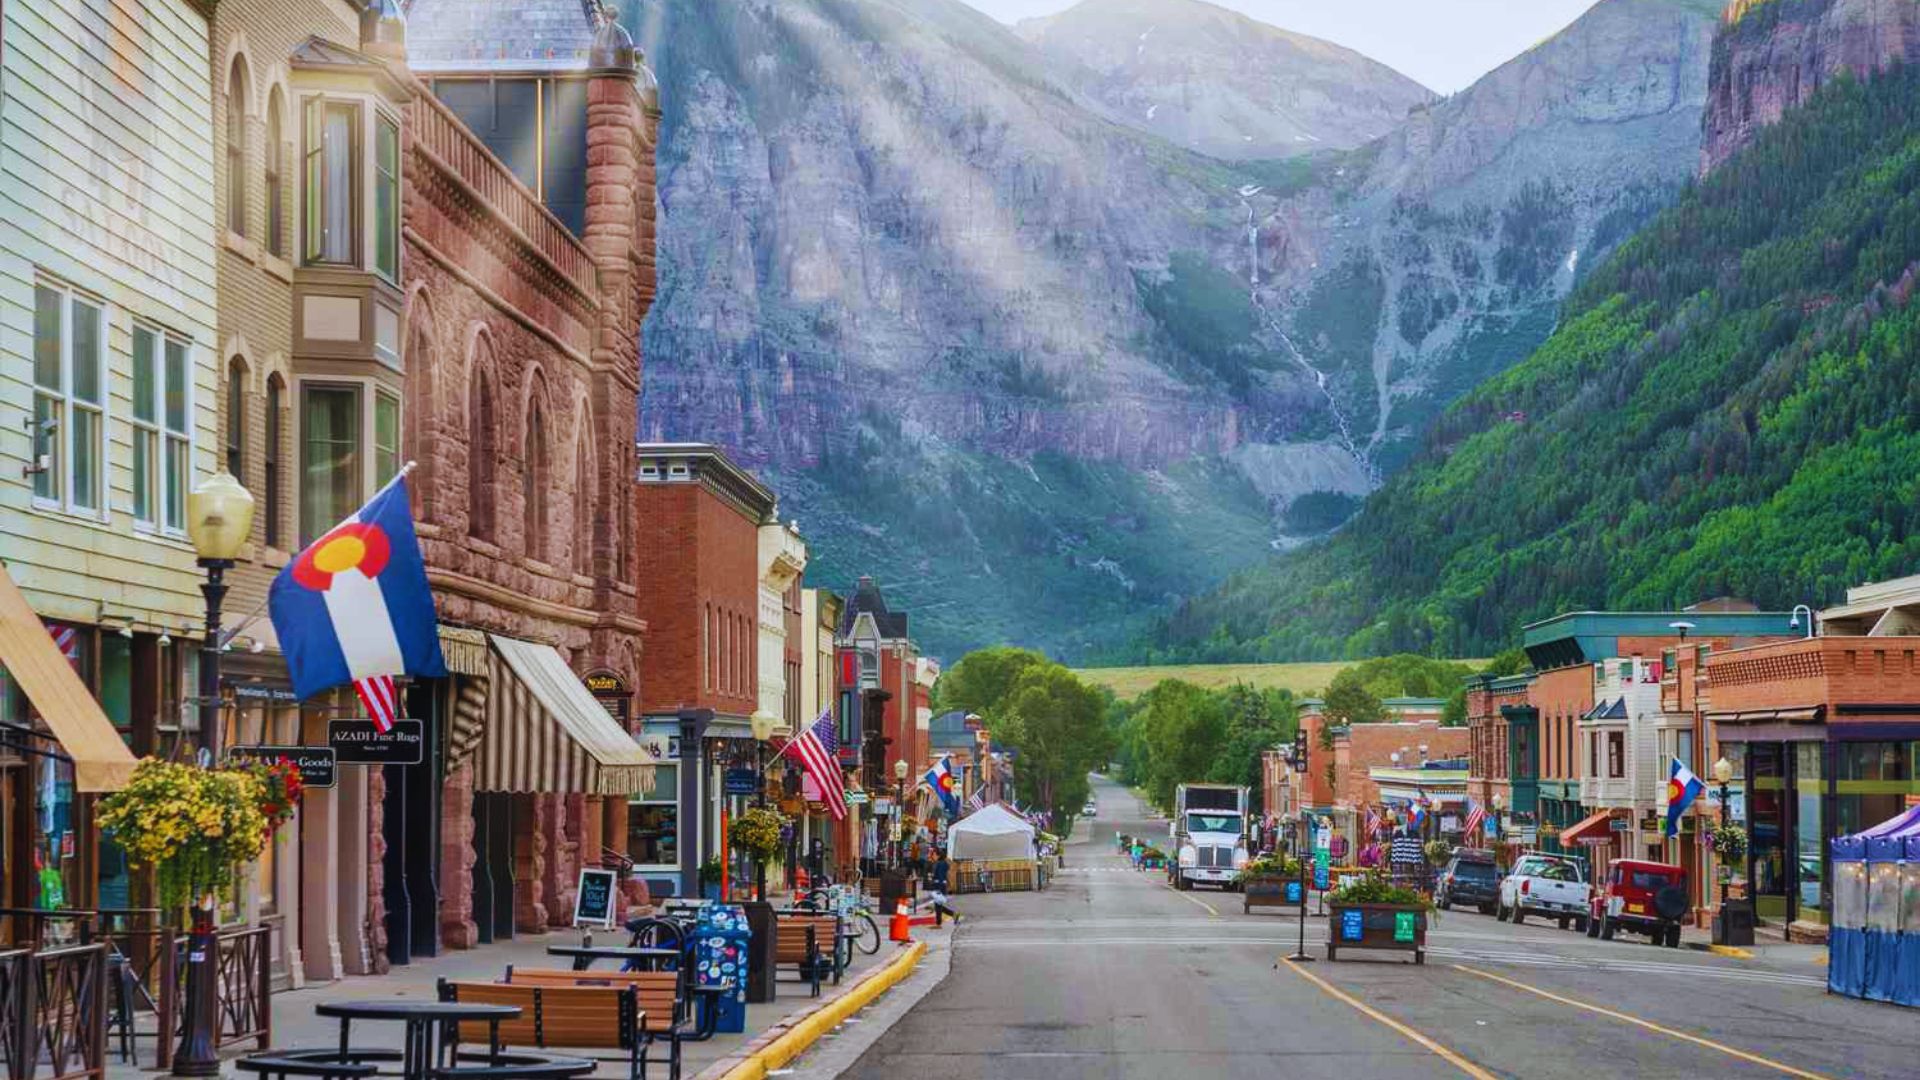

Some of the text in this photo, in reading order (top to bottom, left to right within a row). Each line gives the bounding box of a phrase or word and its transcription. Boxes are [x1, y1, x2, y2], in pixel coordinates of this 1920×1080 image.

[333, 731, 370, 741] AZADI
[397, 731, 420, 743] Rugs
[298, 756, 331, 767] Goods
